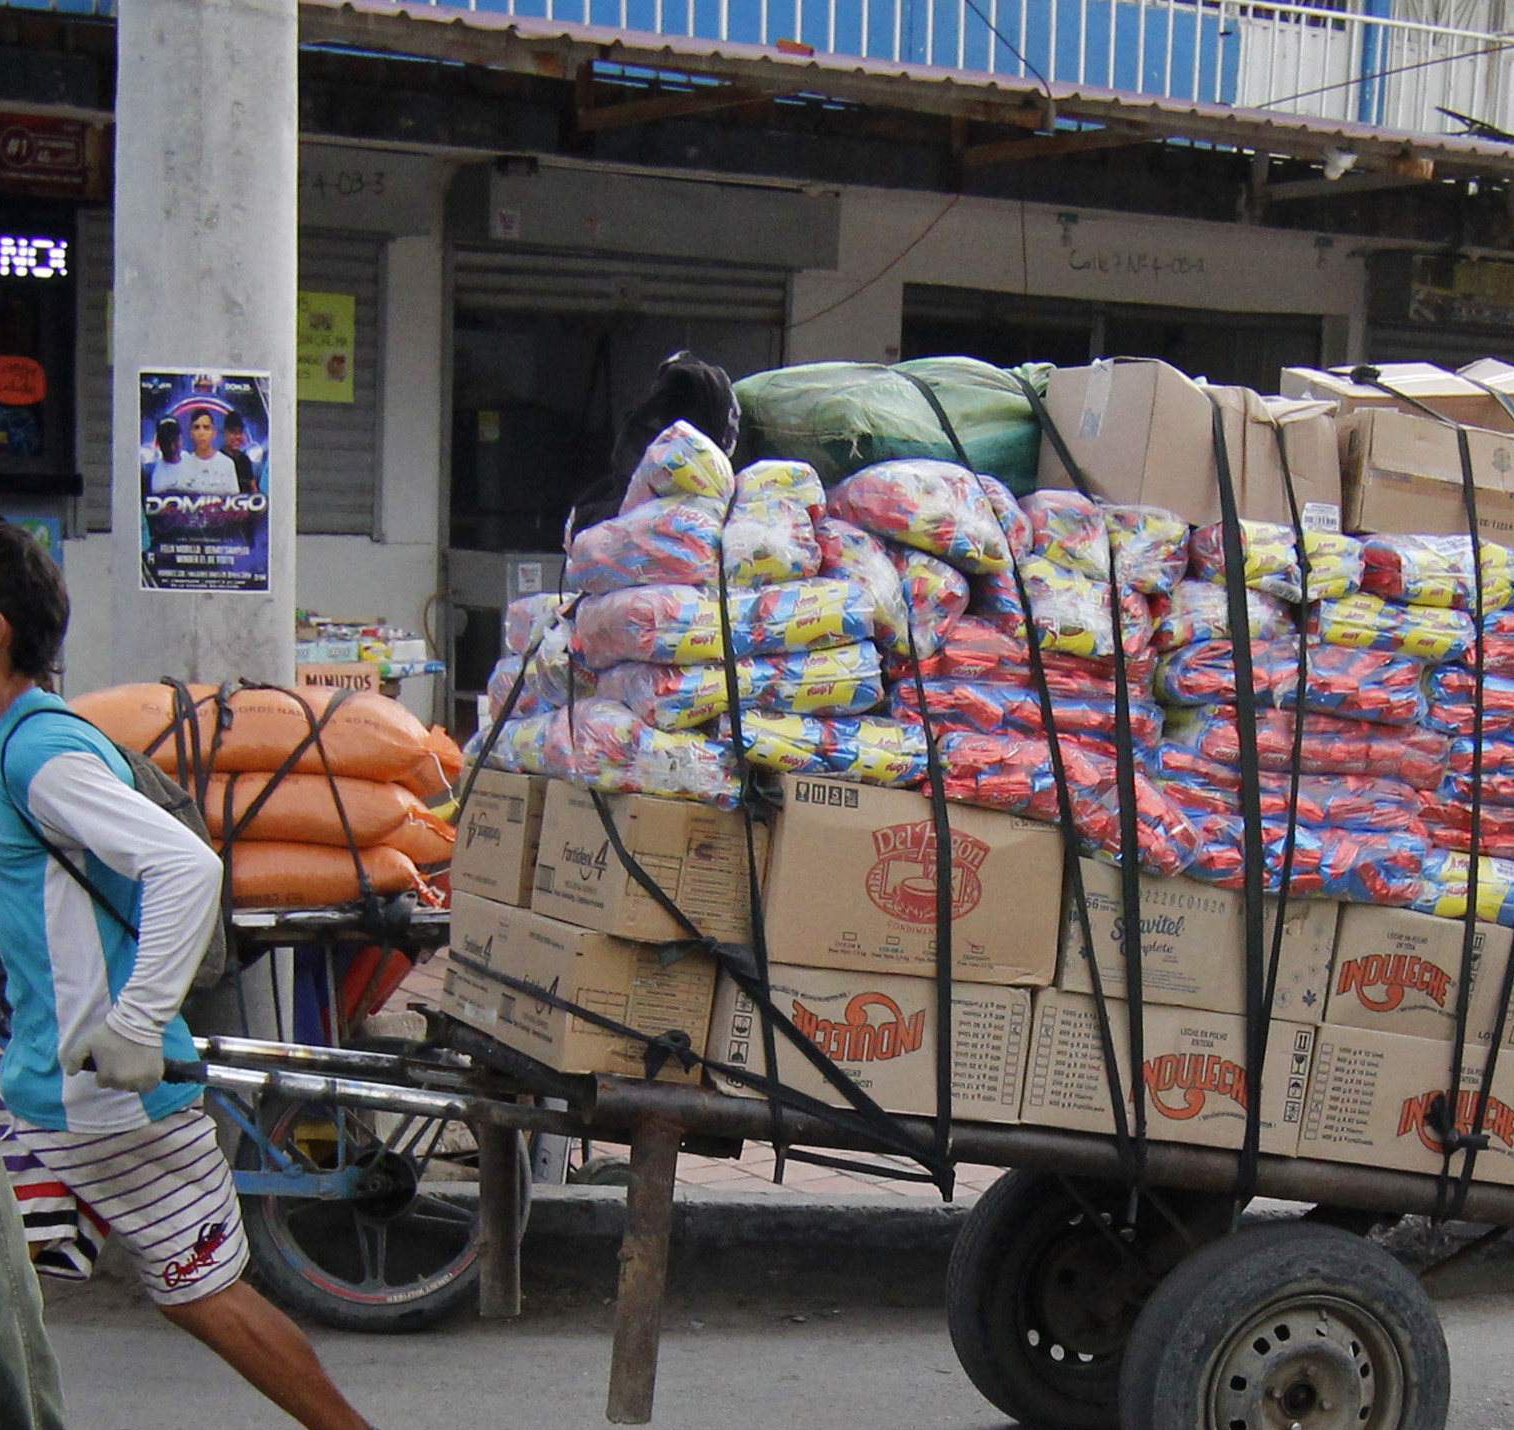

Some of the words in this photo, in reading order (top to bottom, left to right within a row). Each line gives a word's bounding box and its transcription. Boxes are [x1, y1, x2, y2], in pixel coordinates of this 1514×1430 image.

[145, 492, 268, 517] DOMINGO
[305, 673, 372, 691] MINUTOS
[875, 825, 912, 855] Del
[1336, 953, 1452, 1013] INDULECHE
